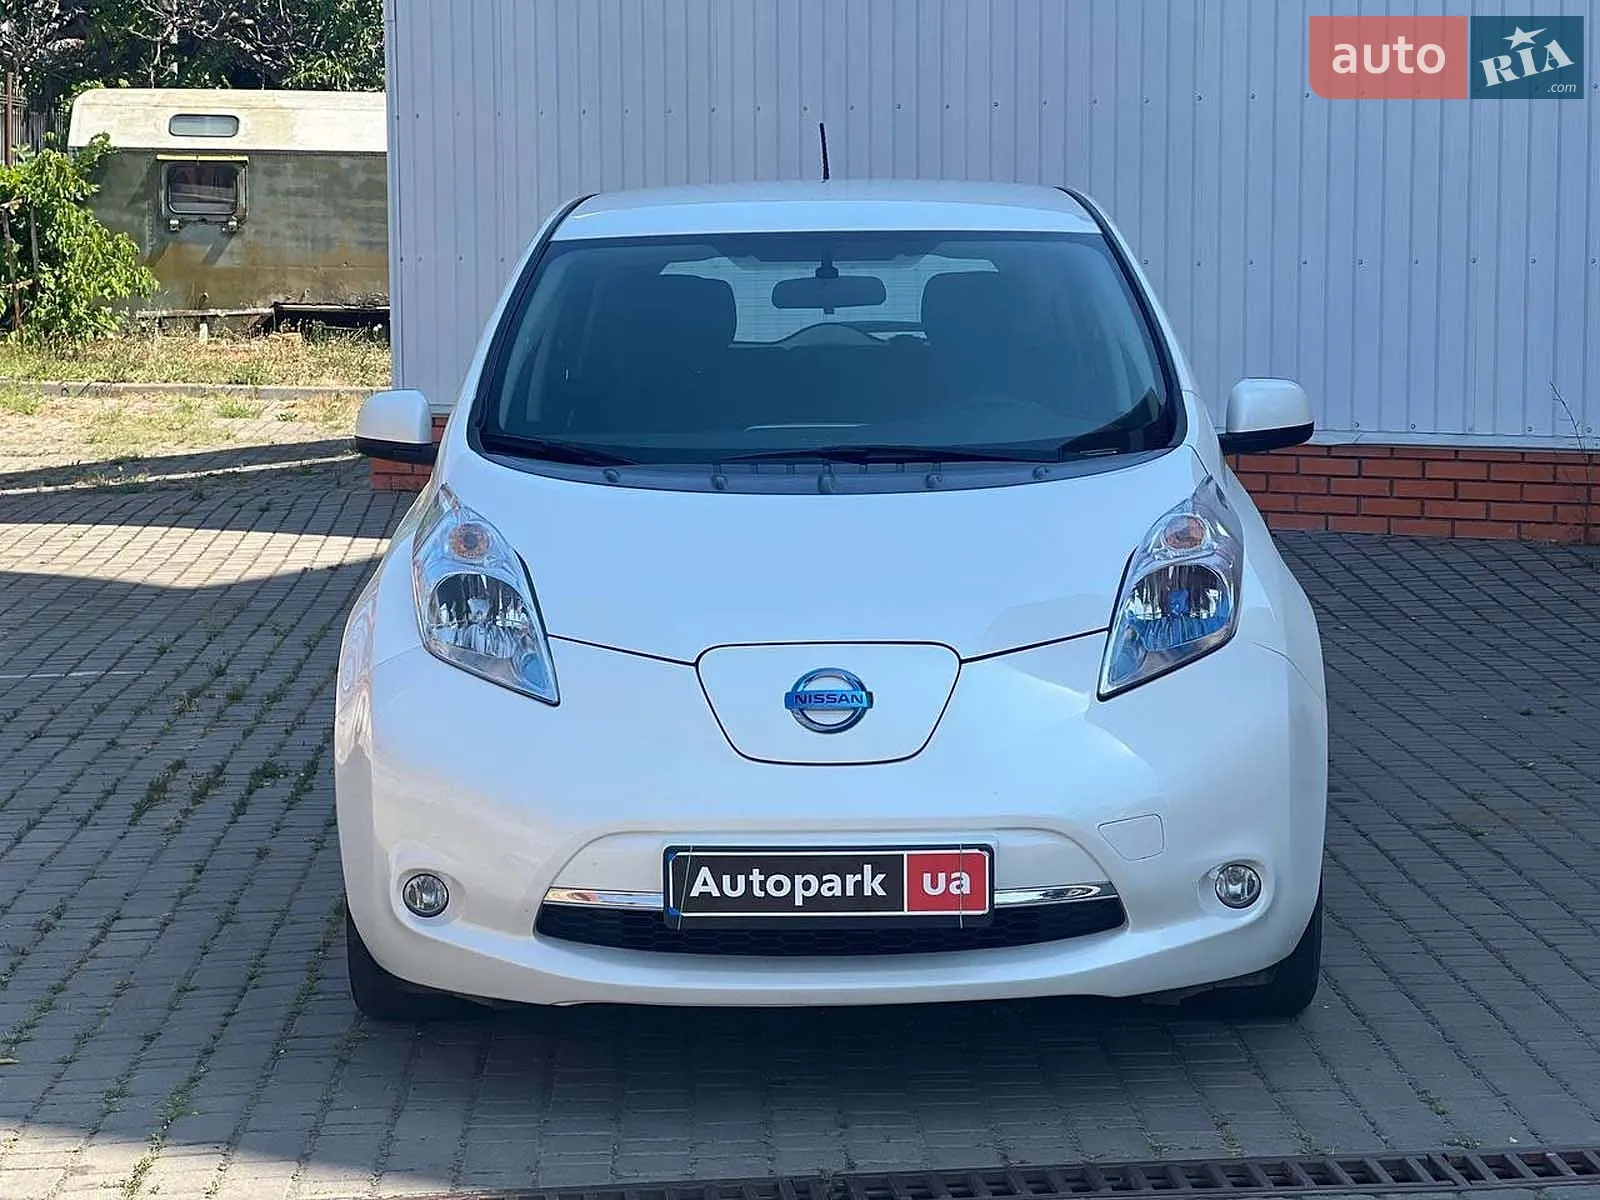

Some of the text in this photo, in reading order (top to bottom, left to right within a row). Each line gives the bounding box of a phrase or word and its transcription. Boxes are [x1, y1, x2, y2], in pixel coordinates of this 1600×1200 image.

[794, 693, 864, 704] NISSAN
[689, 864, 971, 906] Autopark ua
